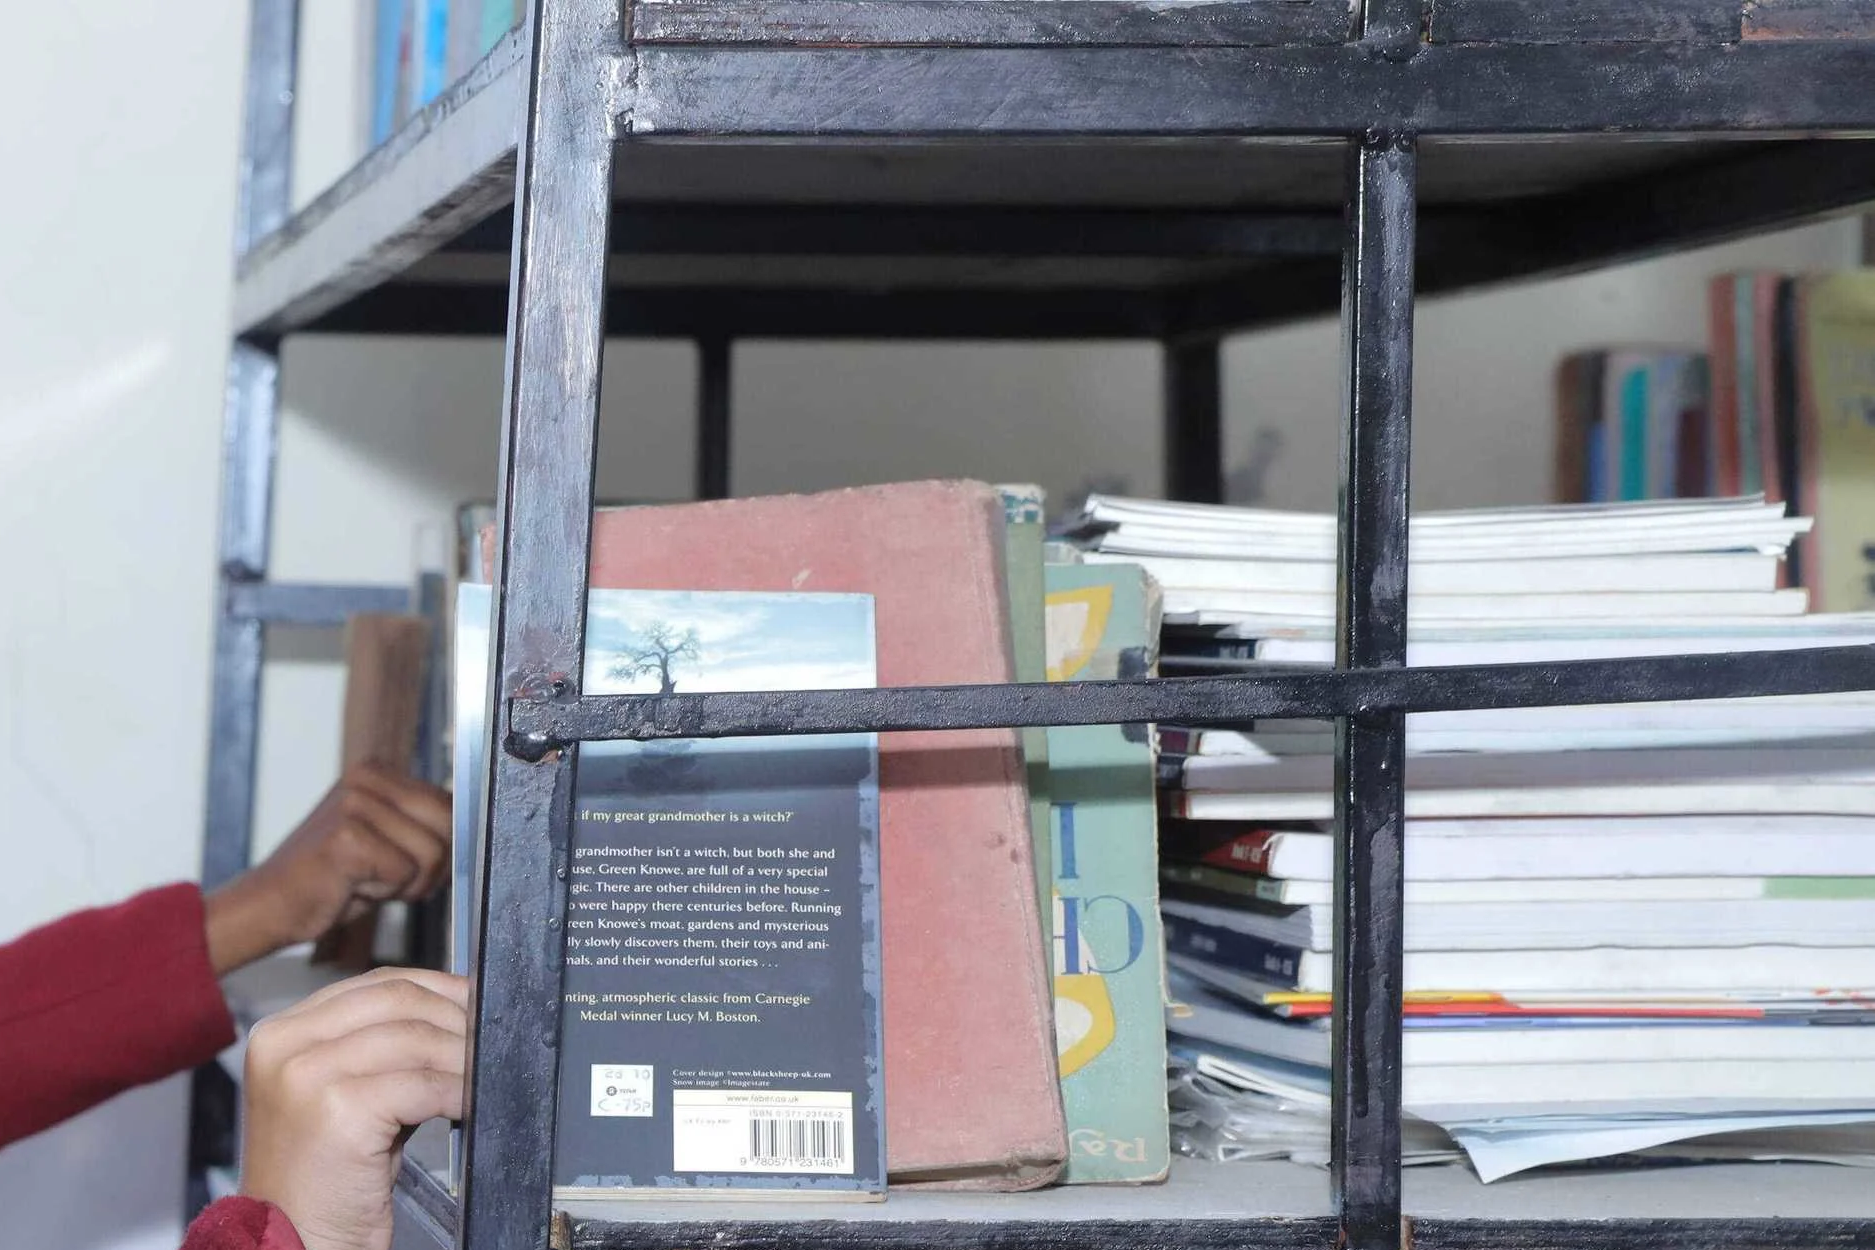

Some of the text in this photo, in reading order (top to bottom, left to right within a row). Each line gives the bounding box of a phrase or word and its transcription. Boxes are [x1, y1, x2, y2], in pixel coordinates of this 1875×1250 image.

[581, 810, 589, 821] if
[593, 813, 611, 823] my
[615, 810, 643, 824] great
[648, 811, 726, 824] grandmother
[730, 811, 739, 822] is
[743, 814, 749, 822] a
[575, 846, 652, 859] grandmother
[656, 847, 681, 857] isn't
[684, 849, 690, 857] a
[733, 848, 753, 858] but
[757, 848, 786, 858] both
[789, 848, 809, 858] she
[813, 848, 835, 859] and
[598, 864, 636, 875] Green
[687, 867, 706, 875] are
[709, 865, 728, 876] full
[732, 866, 744, 876] of
[747, 868, 754, 876] a
[758, 868, 783, 878] very
[786, 866, 828, 878] special
[570, 881, 592, 895] gic.
[595, 882, 630, 893] There
[633, 885, 653, 893] are
[656, 882, 689, 893] other
[692, 883, 741, 894] children
[745, 883, 756, 894] in
[760, 883, 780, 894] the
[784, 884, 820, 894] house
[579, 903, 608, 911] were
[611, 900, 648, 913] happy
[652, 901, 683, 912] there
[687, 901, 742, 912] centuries
[746, 902, 787, 912] before.
[791, 902, 842, 915] Running
[598, 918, 646, 929] Knowe's
[687, 919, 734, 932] gardens
[737, 919, 760, 931] and
[764, 920, 829, 933] mysterious
[584, 936, 621, 949] slowly
[624, 937, 679, 948] discovers
[721, 938, 750, 948] their
[753, 938, 777, 951] toys
[780, 938, 803, 949] and
[807, 938, 829, 949] ani-
[596, 955, 619, 966] and
[622, 955, 651, 966] their
[654, 956, 715, 966] wonderful
[719, 956, 758, 967] stories
[602, 992, 676, 1005] atmospheric
[680, 993, 719, 1004] classic
[723, 993, 751, 1004] from
[755, 993, 811, 1006] Carnegie
[580, 1011, 761, 1024] Medal winner Lucy M. Boston.
[672, 1069, 695, 1077] Cover
[698, 1069, 724, 1078] design
[696, 1079, 719, 1087] image
[740, 1157, 747, 1166] 9
[755, 1157, 794, 1167] 780571
